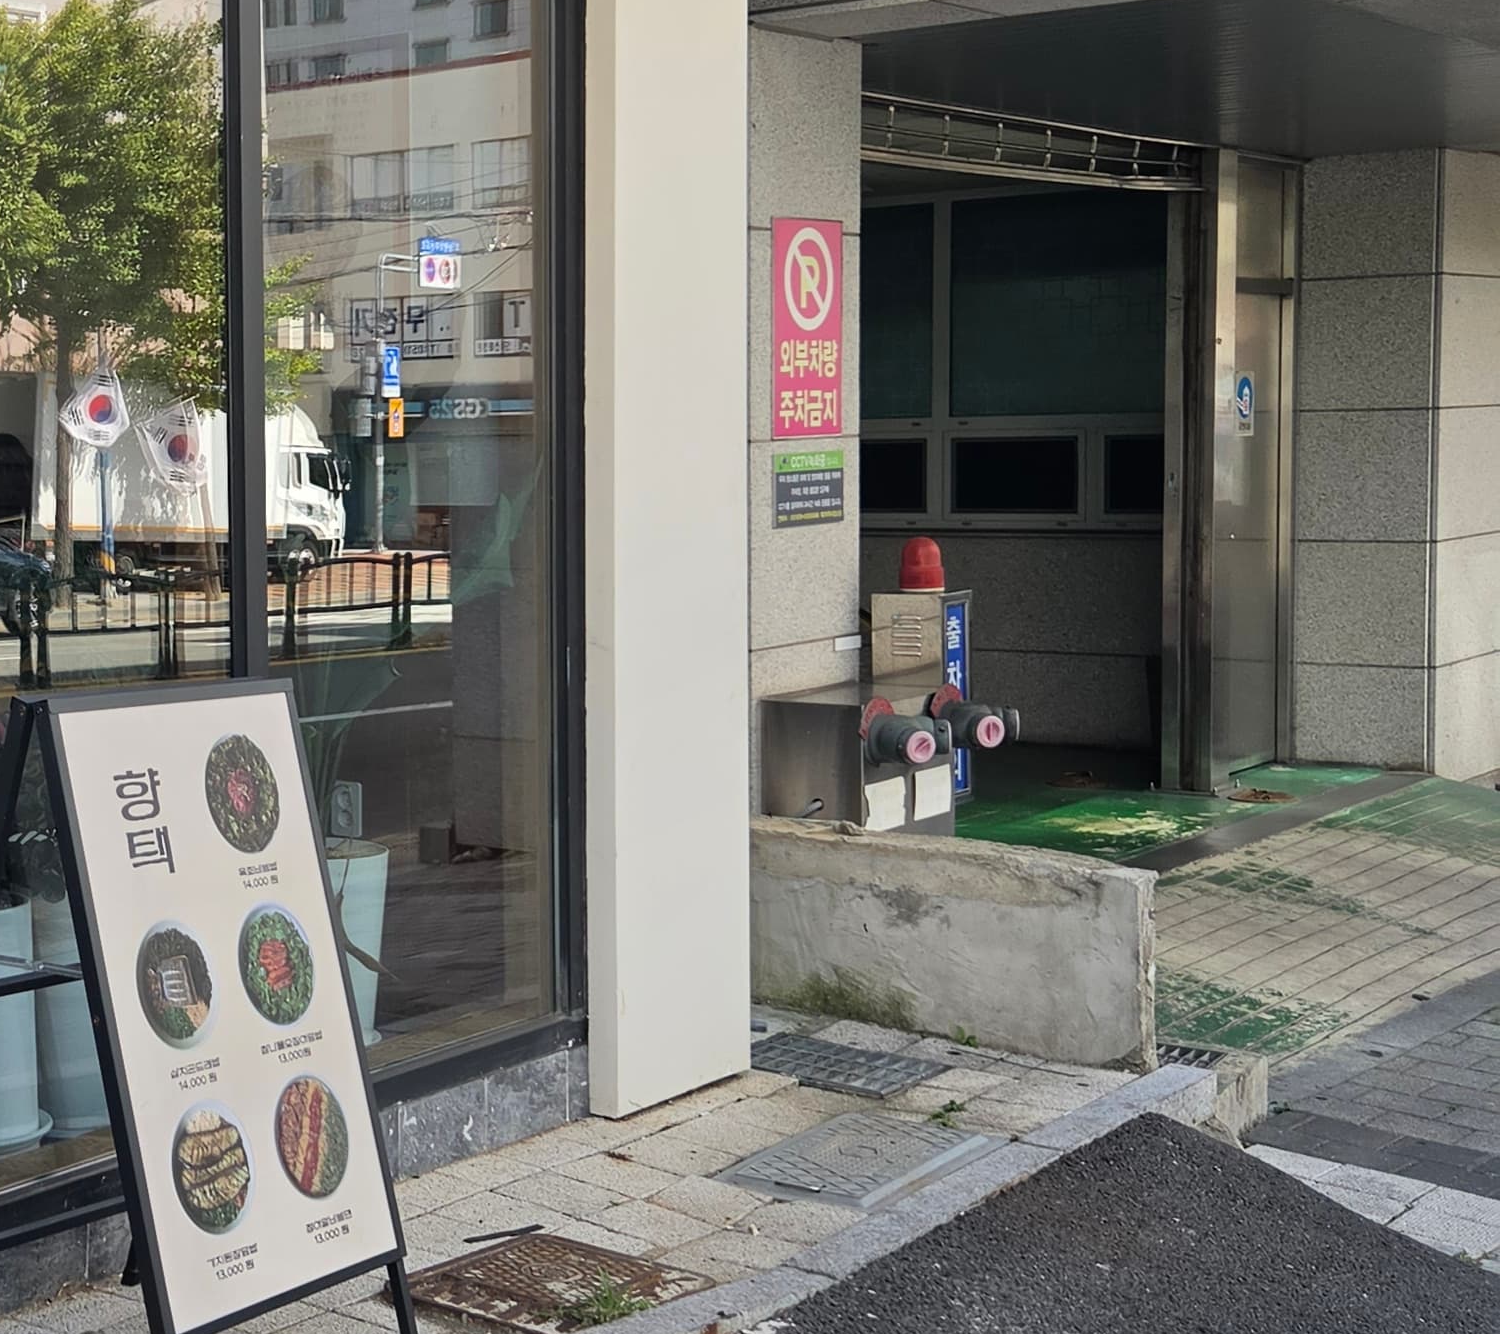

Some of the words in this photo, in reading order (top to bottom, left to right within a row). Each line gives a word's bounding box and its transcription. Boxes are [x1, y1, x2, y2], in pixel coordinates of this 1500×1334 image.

[780, 339, 838, 378] 외부차량
[779, 389, 837, 428] 주차금지
[113, 768, 176, 873] 향택
[243, 876, 269, 889] 14,000
[178, 1074, 207, 1091] 14,000
[314, 1227, 340, 1244] 13,000
[216, 1262, 245, 1280] 13,000
